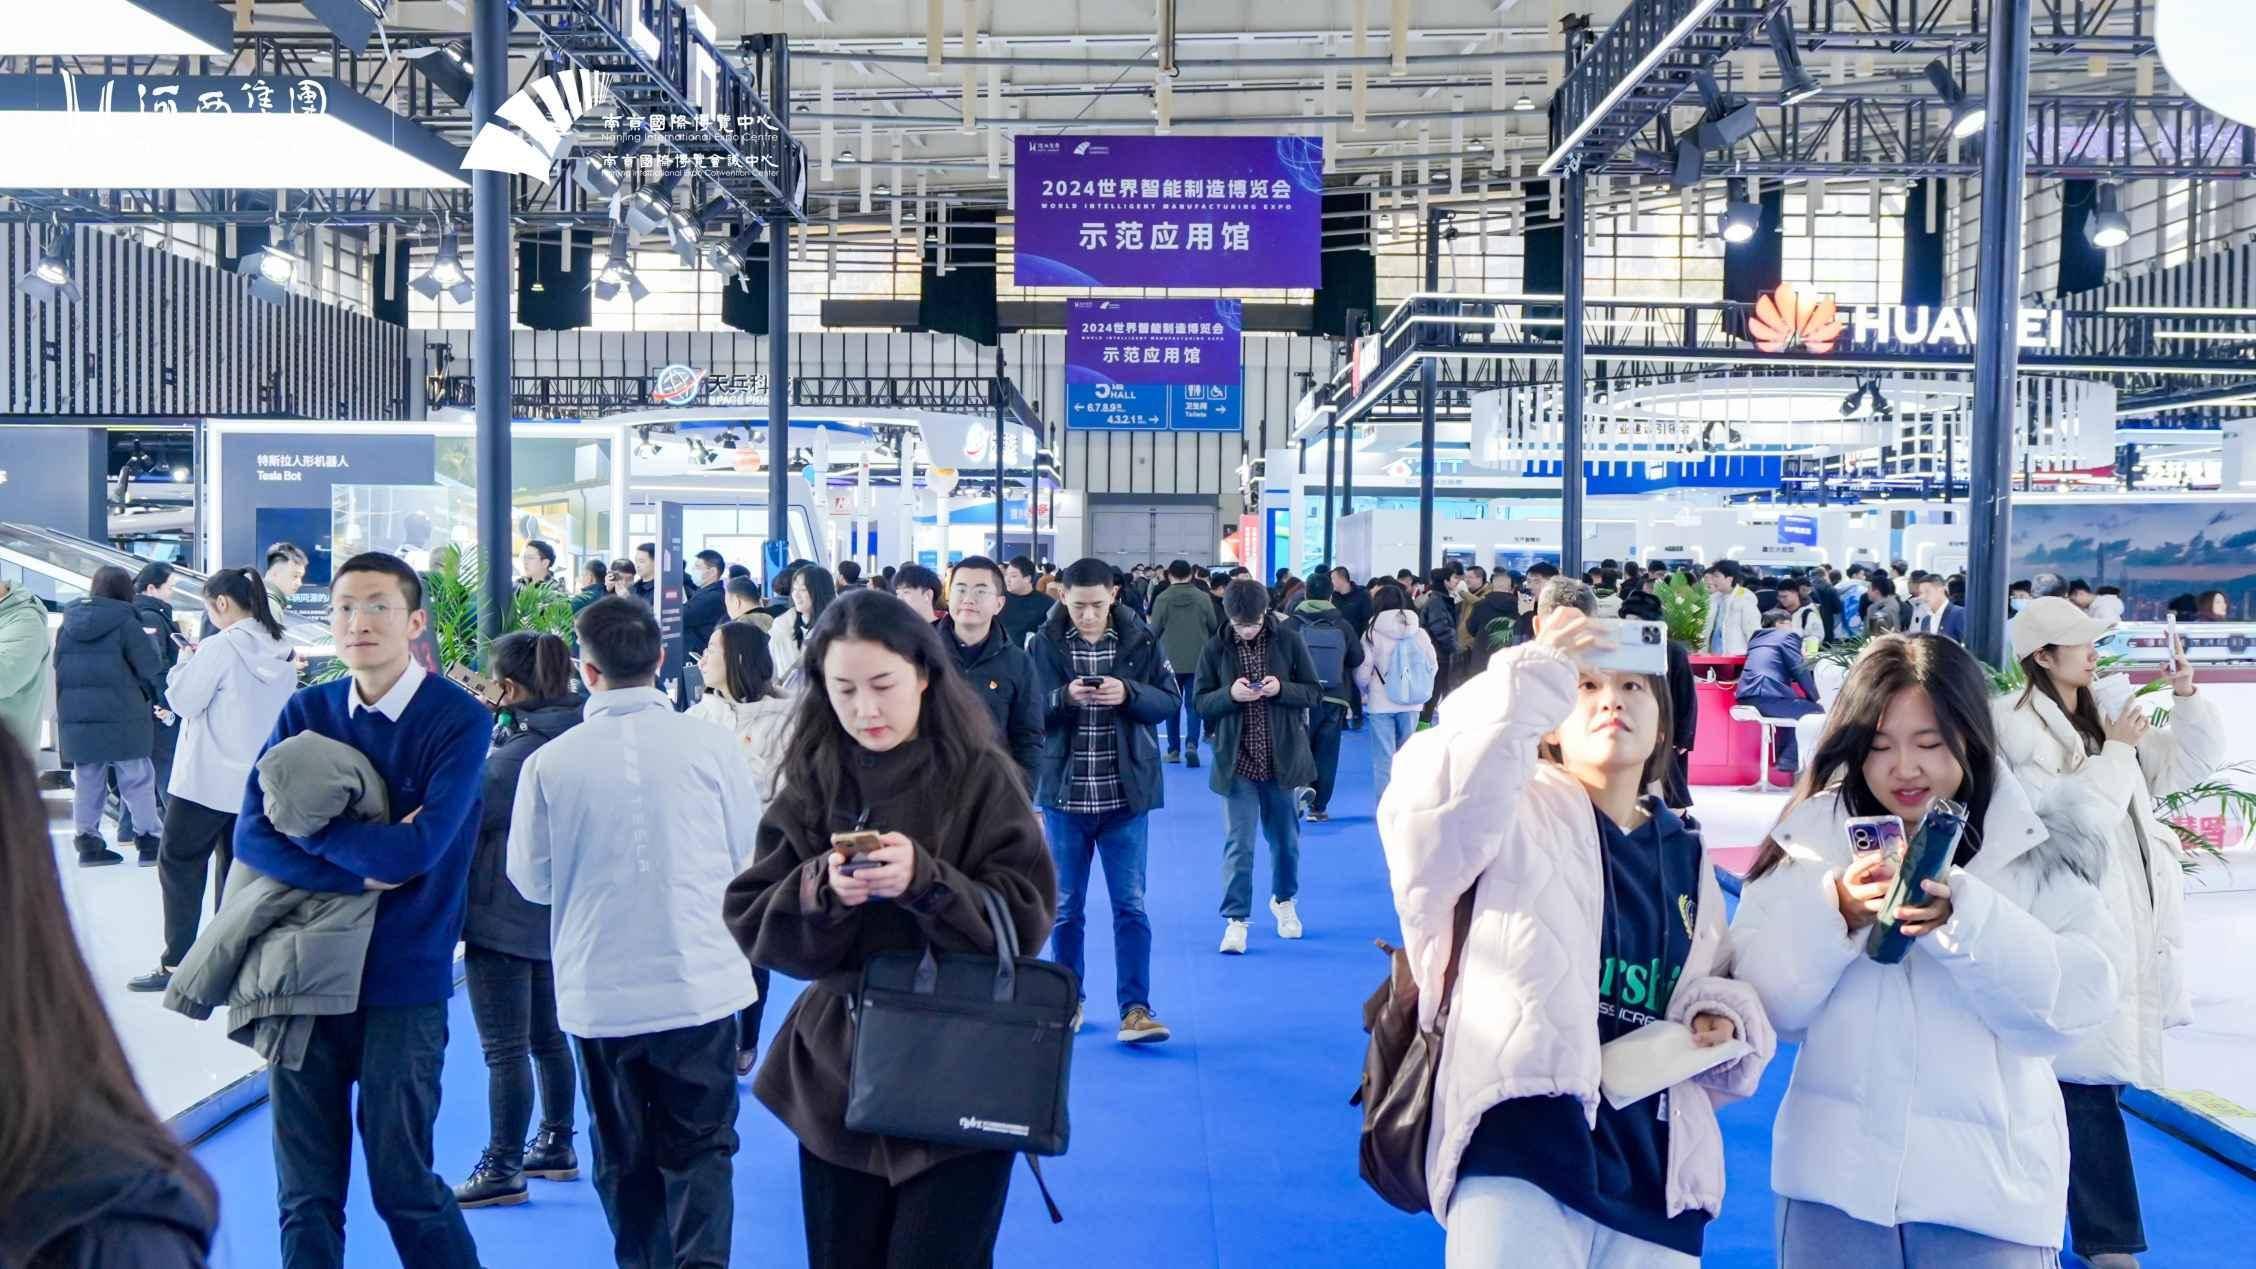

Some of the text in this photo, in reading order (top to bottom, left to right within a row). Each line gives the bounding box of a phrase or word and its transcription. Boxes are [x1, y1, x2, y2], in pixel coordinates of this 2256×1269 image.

[1042, 179, 1291, 199] 2024世界智能制造博览会
[1079, 222, 1250, 250] 示范应用馆
[1081, 322, 1224, 335] 2024世界智能制造博览会
[1854, 305, 2063, 349] HUAEI
[1103, 347, 1201, 364] 示范应用馆
[708, 374, 770, 394] 天兵科
[284, 470, 302, 481] Bot
